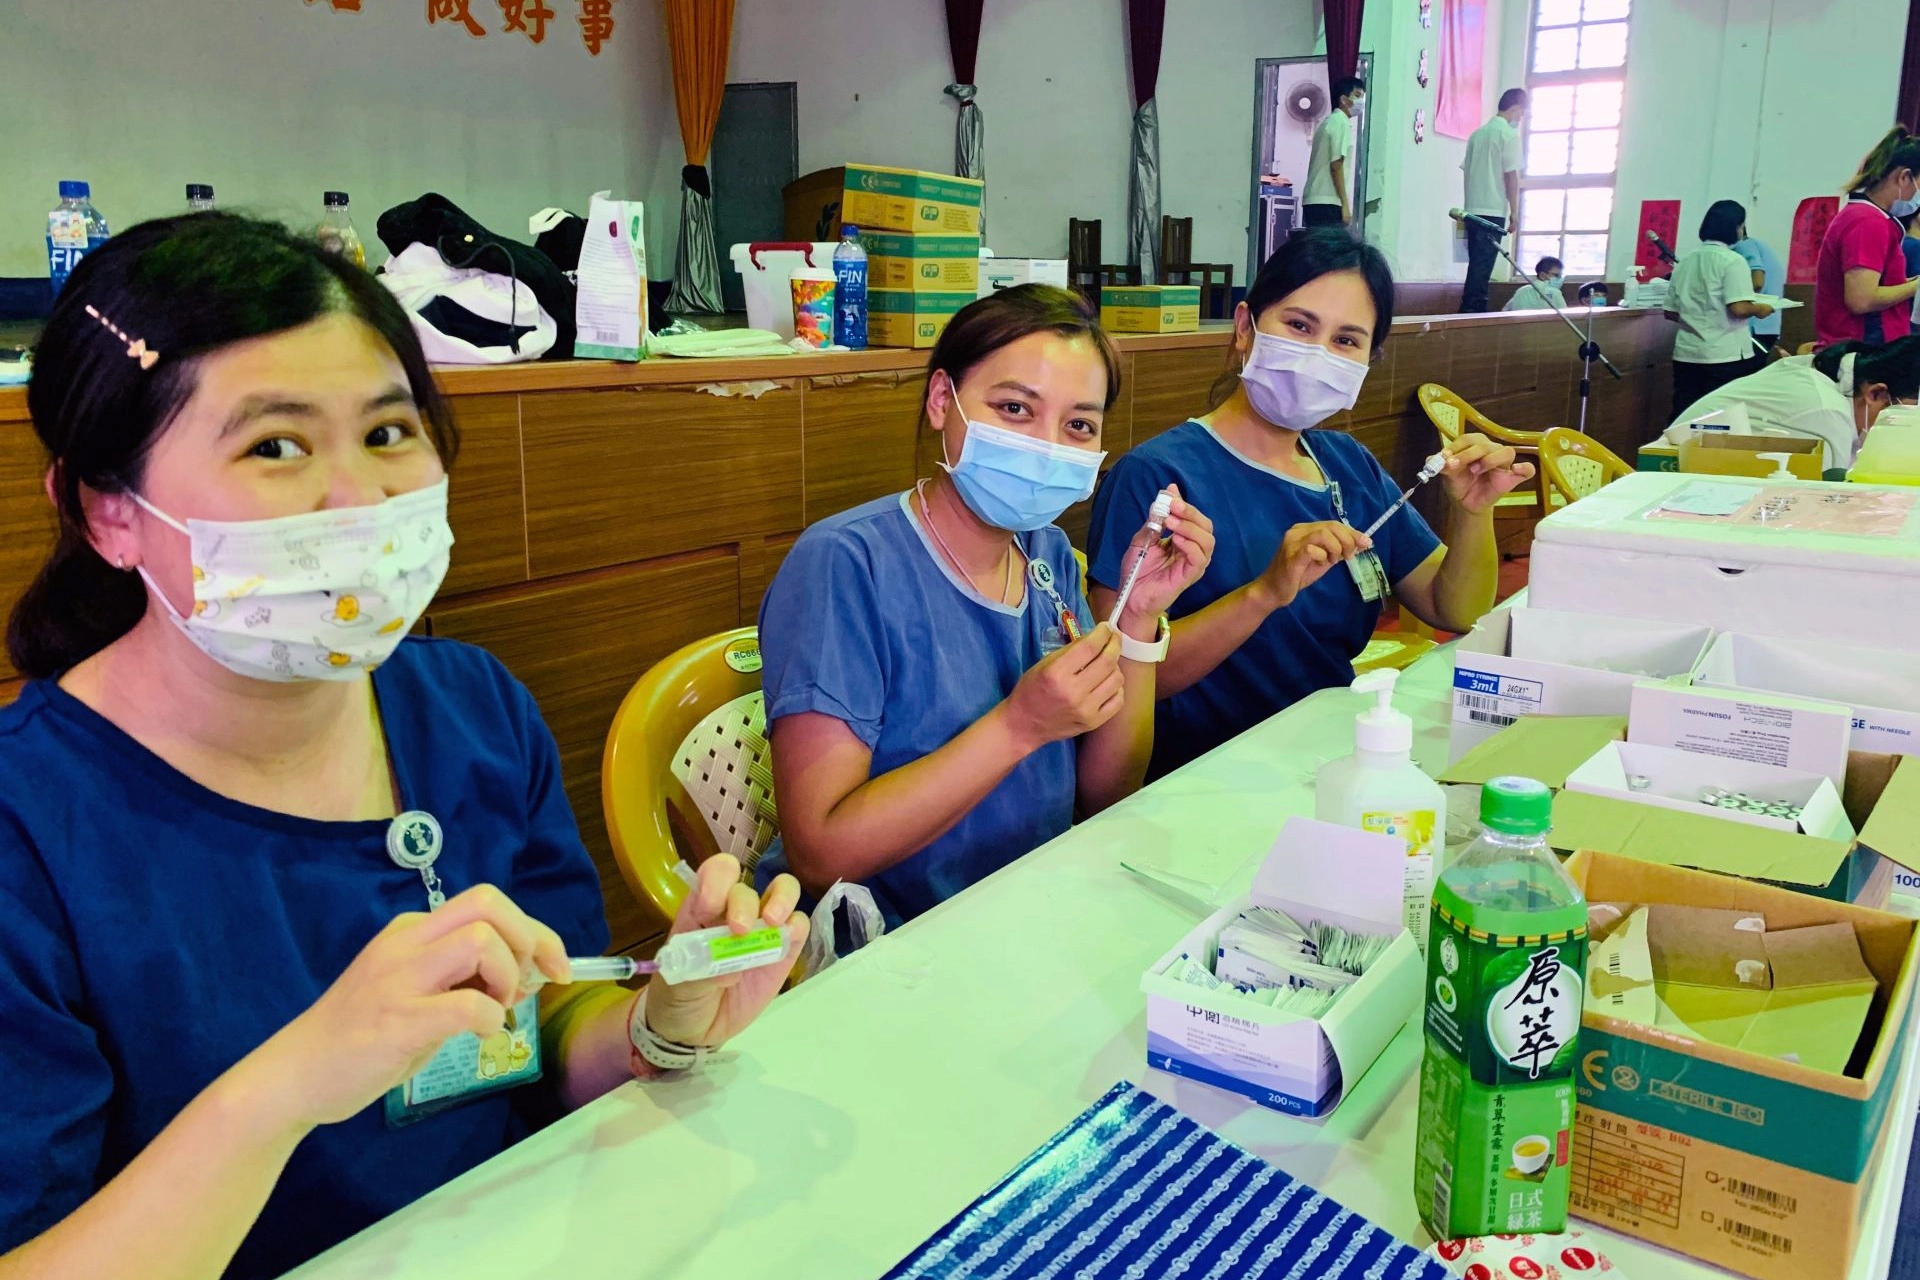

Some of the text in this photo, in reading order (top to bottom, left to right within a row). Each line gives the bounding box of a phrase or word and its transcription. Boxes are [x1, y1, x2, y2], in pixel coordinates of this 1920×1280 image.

[838, 269, 862, 284] FIN
[1470, 679, 1497, 693] 3mL
[1708, 712, 1732, 720] FOSUN
[1851, 717, 1912, 736] GE WITH NEEDLE
[1503, 946, 1561, 1078] 原萃
[1268, 1092, 1301, 1109] 200 PCS
[1660, 1084, 1722, 1111] STERILE
[1509, 1189, 1543, 1210] 日式
